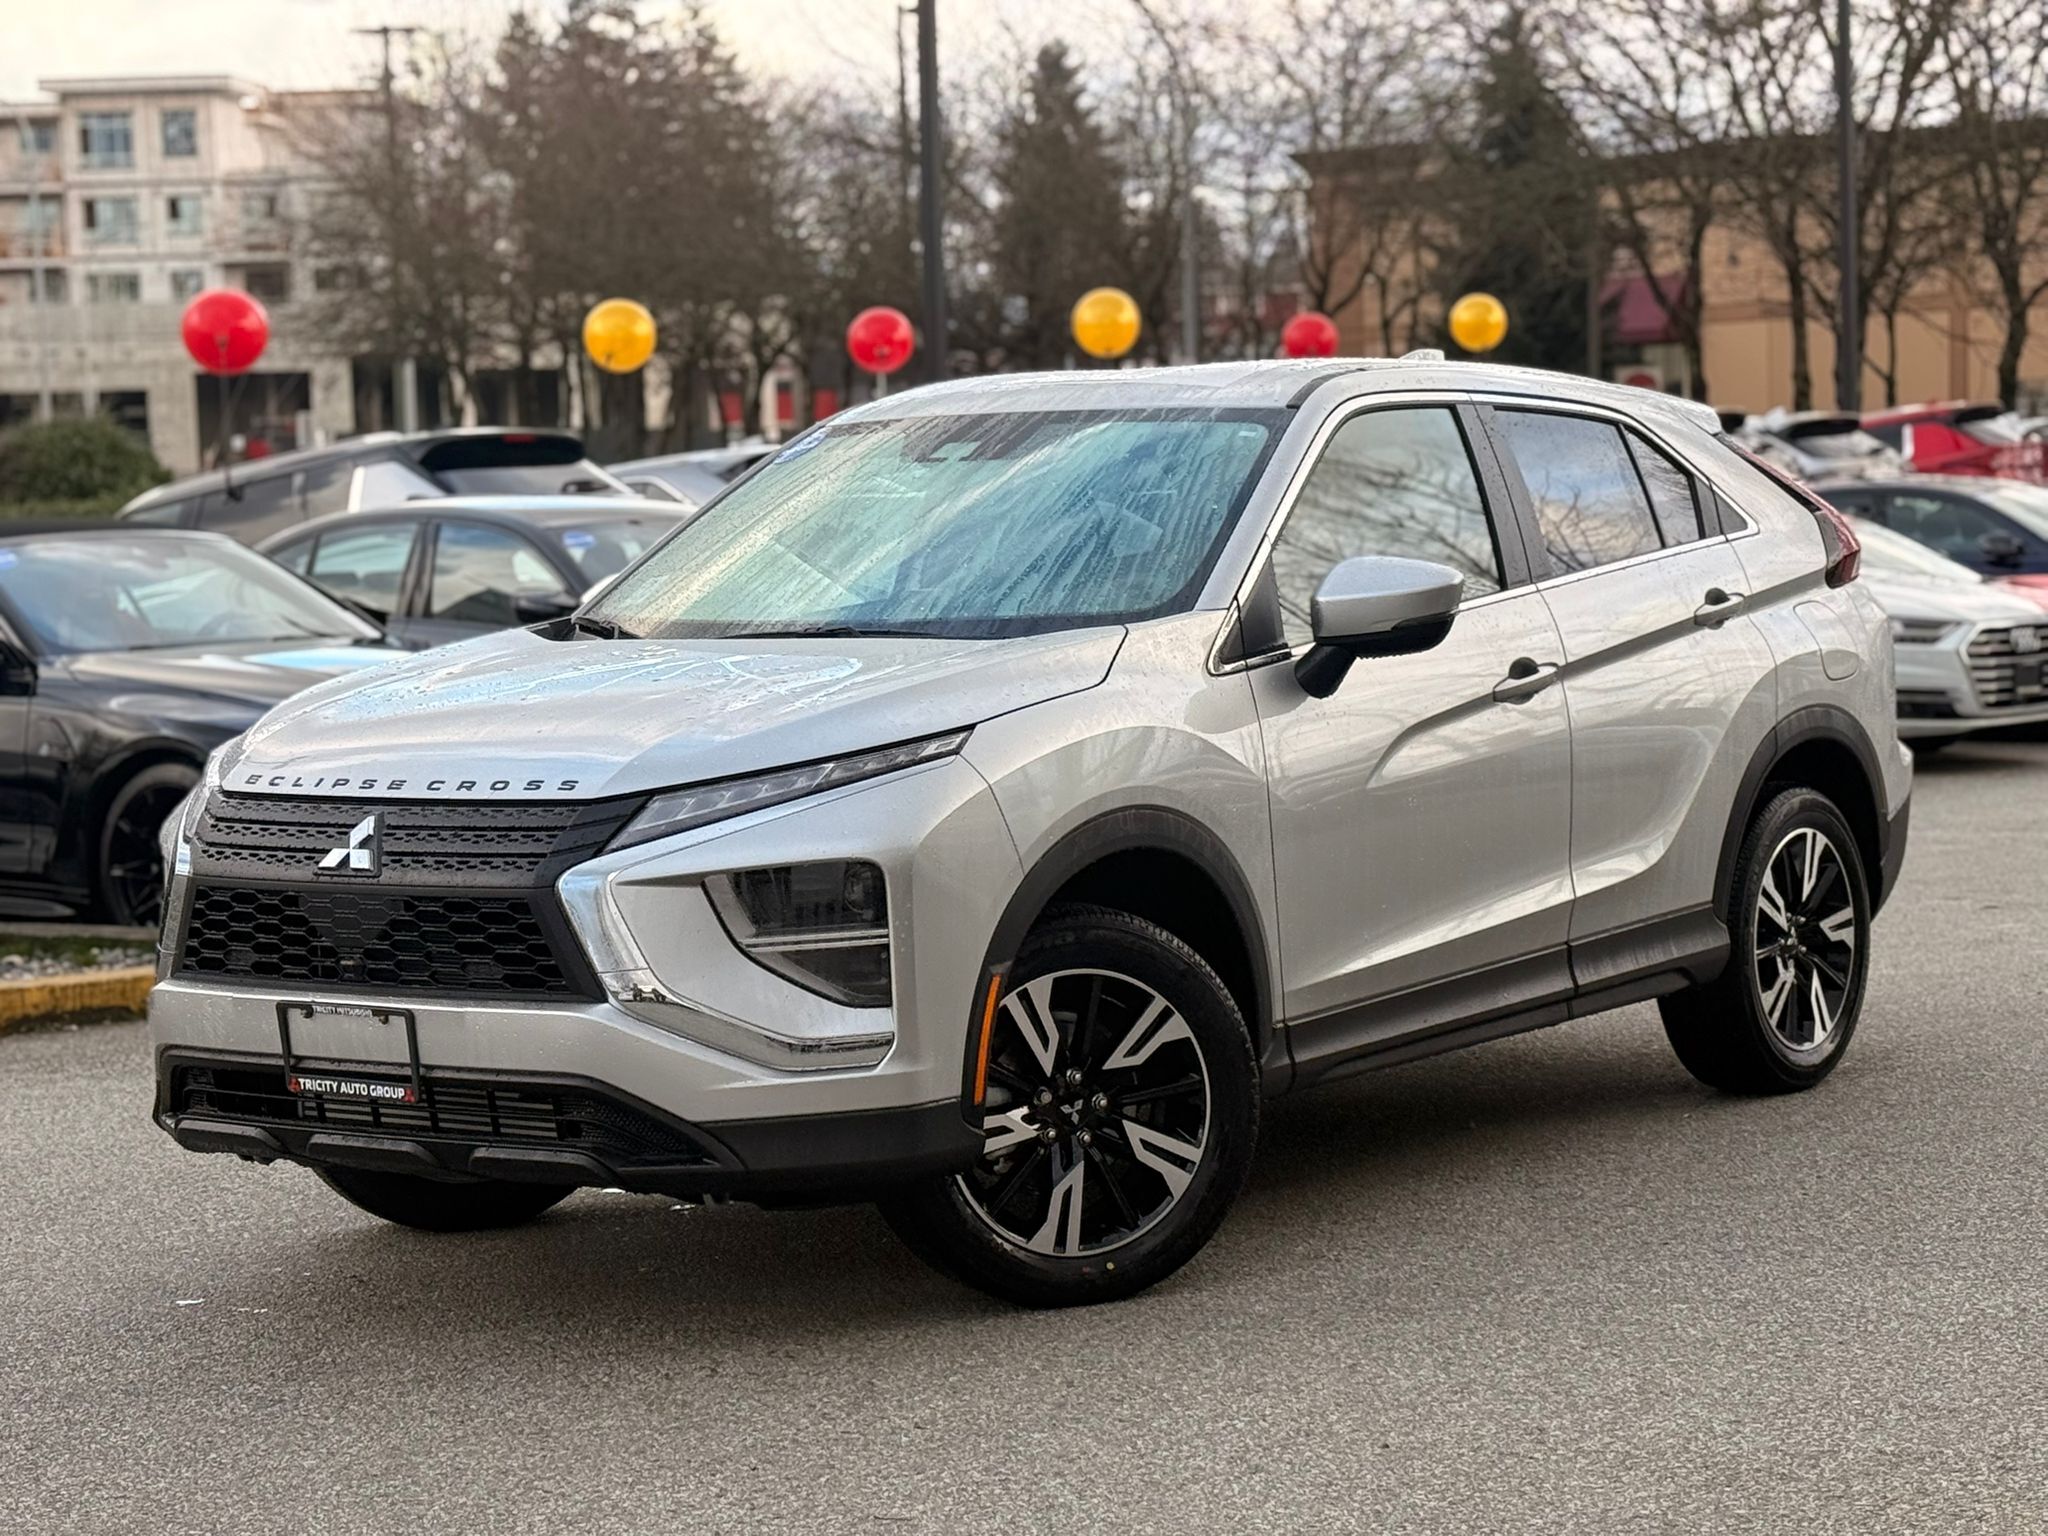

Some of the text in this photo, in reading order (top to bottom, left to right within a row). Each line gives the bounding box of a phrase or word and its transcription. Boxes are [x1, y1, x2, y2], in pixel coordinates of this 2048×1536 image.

[245, 774, 579, 792] ECLIPSE CROSS
[298, 1078, 405, 1099] TRICITY AUTO GROUP
